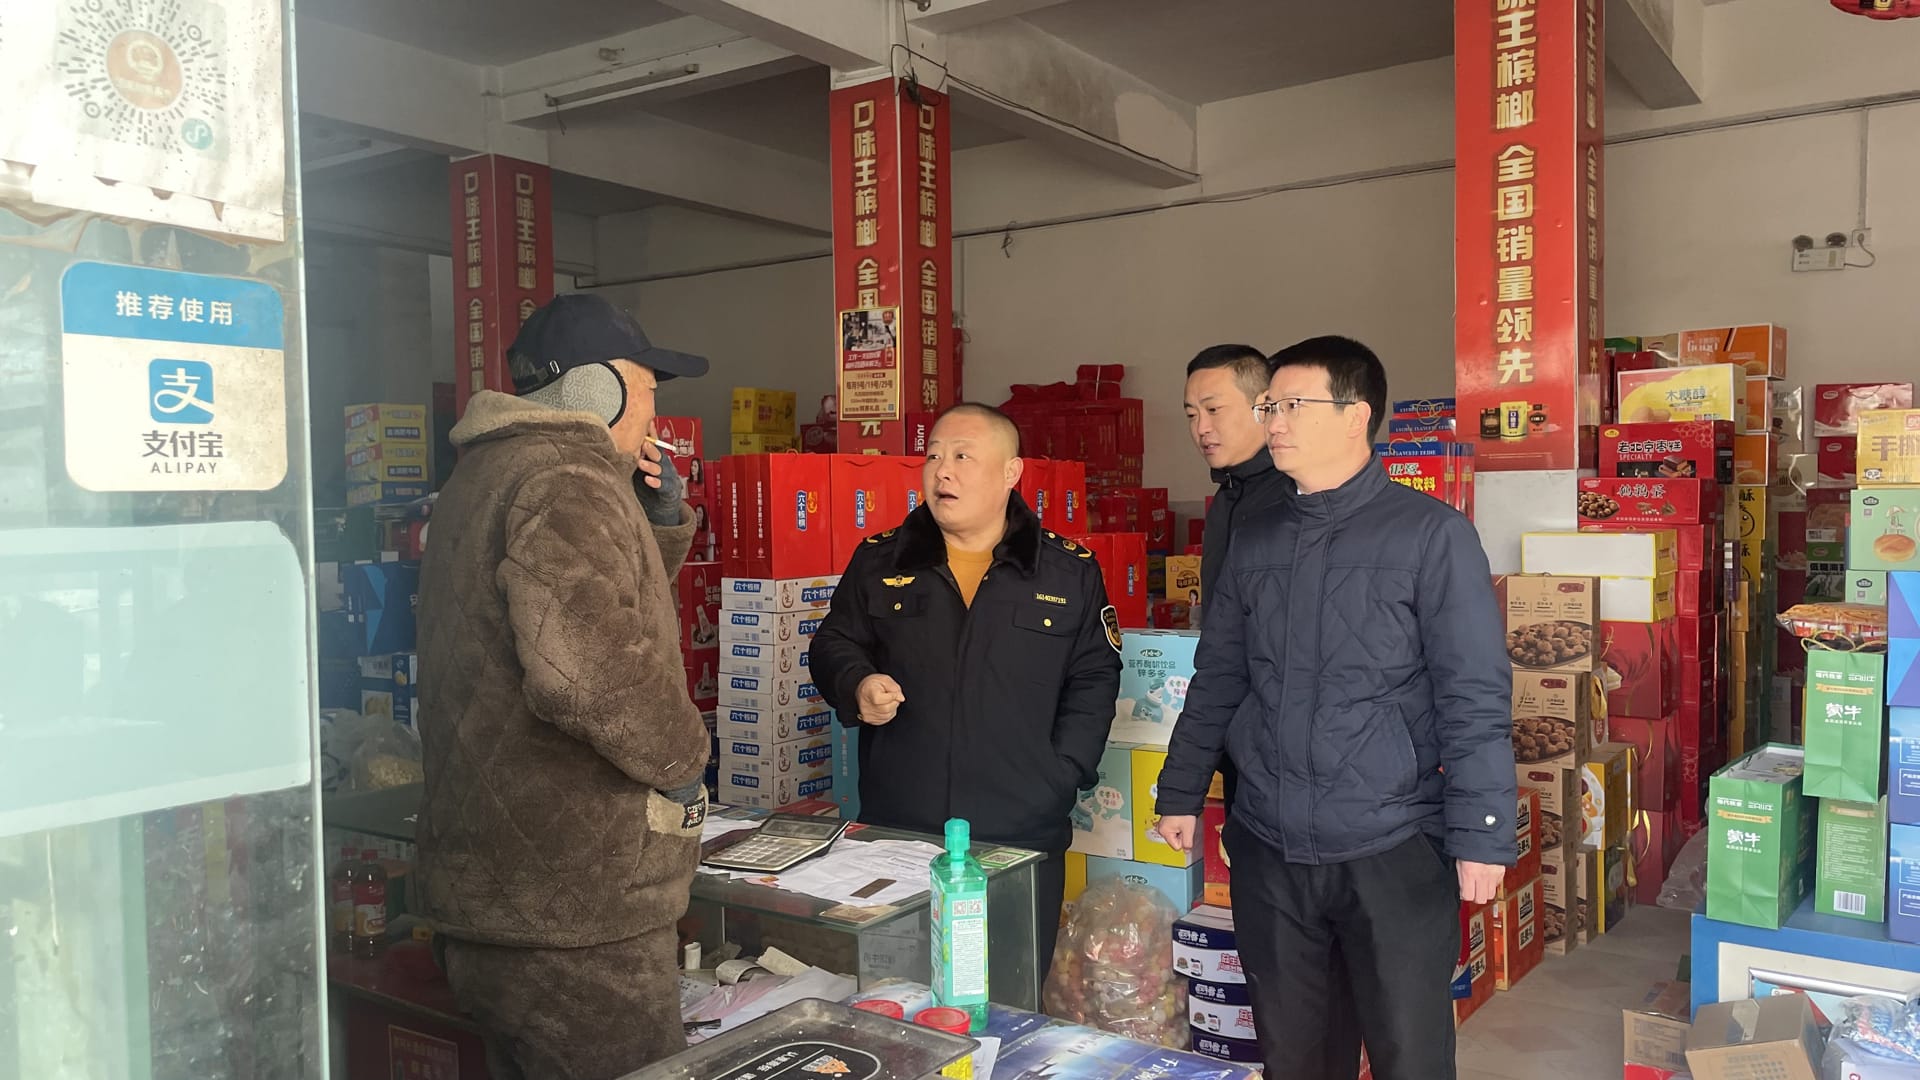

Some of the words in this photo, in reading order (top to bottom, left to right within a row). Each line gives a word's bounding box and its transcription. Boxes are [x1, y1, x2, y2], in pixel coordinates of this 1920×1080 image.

[1497, 0, 1536, 129] 王槟榔
[854, 99, 878, 248] 口味王槟榔
[919, 103, 937, 248] 口味王槟榔
[464, 172, 483, 289] 口味王槟榔
[515, 173, 536, 289] 口味王槟榔
[1497, 144, 1535, 385] 全国销量领先
[115, 290, 234, 326] 推荐使用
[921, 259, 938, 412] 全国销量领
[1665, 386, 1706, 401] 木糖醇
[142, 430, 224, 459] 支付宝
[151, 462, 219, 476] ALIPAY
[798, 494, 806, 528] 六个核桃
[857, 492, 865, 527] 六个核桃
[735, 583, 760, 592] 六个核桃
[732, 615, 759, 624] 六个核桃
[733, 646, 760, 656] 六个核桃
[731, 678, 758, 688] 六个核桃
[731, 711, 758, 721] 六个核桃
[799, 713, 831, 728] 六个核桃
[1826, 702, 1862, 721] 蒙牛
[733, 743, 759, 754] 六个核桃
[733, 775, 759, 786] 六个核桃
[1727, 829, 1761, 848] 蒙牛
